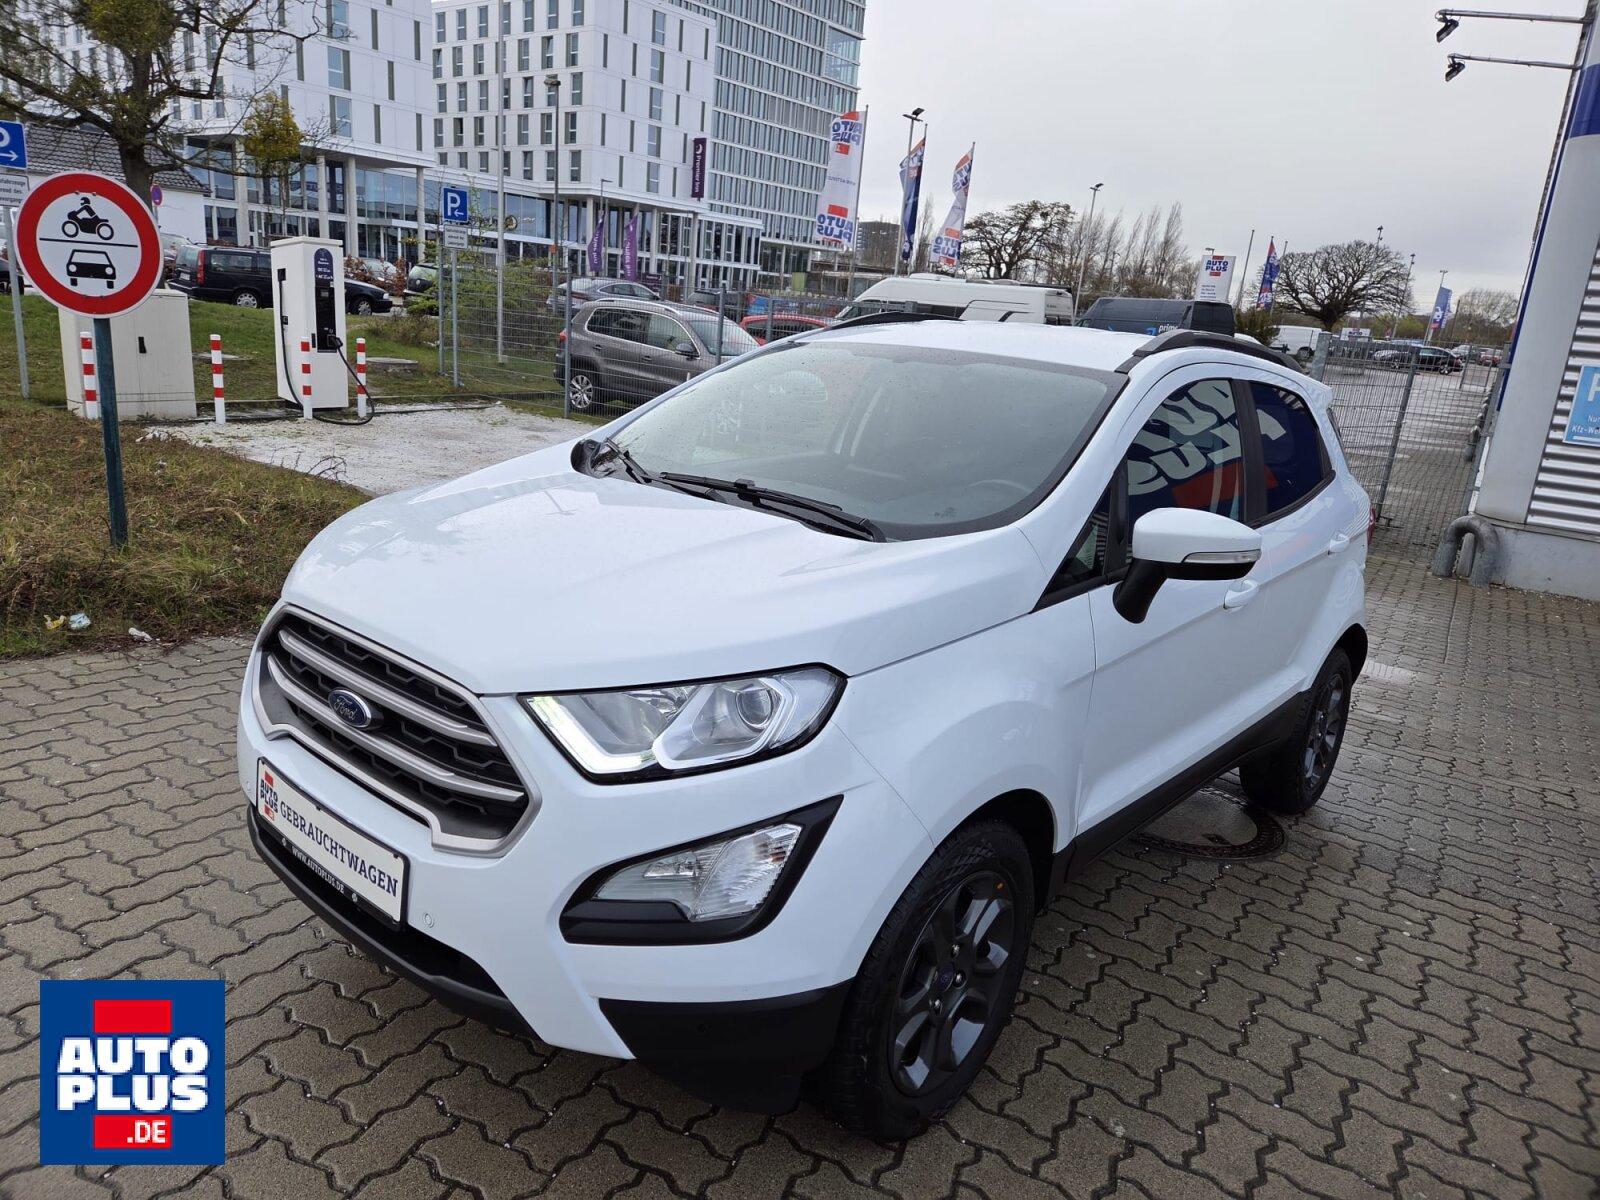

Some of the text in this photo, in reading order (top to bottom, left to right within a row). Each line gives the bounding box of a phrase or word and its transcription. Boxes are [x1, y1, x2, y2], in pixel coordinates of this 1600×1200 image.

[447, 192, 461, 217] P
[1571, 425, 1600, 434] Kfz-We
[333, 695, 358, 720] Ford
[260, 778, 278, 803] AUTO
[260, 789, 278, 814] PLUS
[280, 800, 398, 897] GEBRAUCHTWAGEN
[291, 845, 345, 893] WWW.AUTOPLUS.DE
